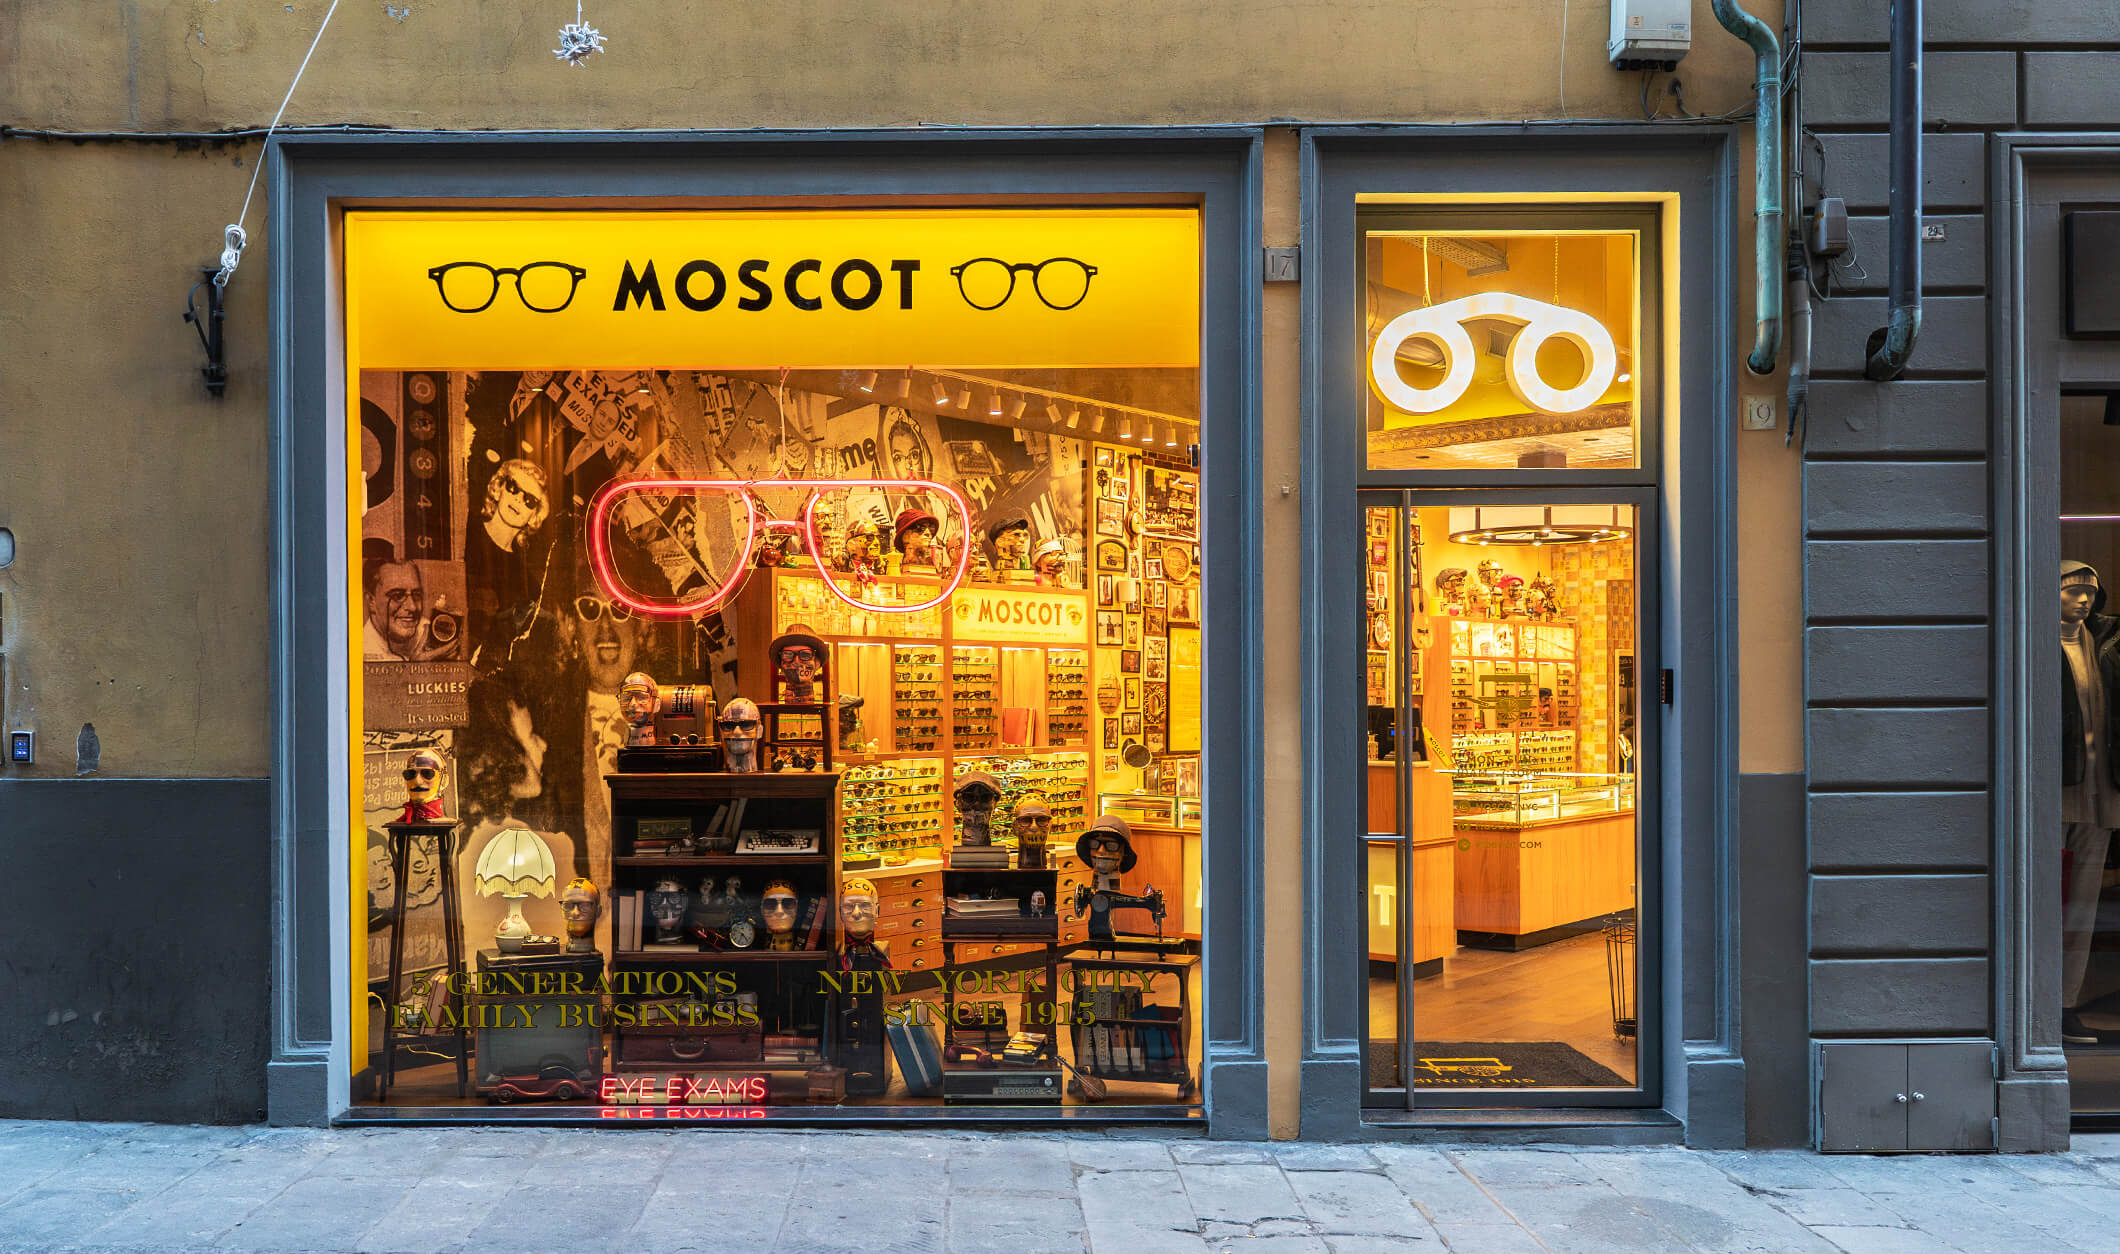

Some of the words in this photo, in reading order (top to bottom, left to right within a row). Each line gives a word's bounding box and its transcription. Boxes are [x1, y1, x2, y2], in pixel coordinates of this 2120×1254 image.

[1271, 254, 1295, 276] 17
[612, 258, 921, 312] MOSCOT
[416, 455, 433, 471] 3
[416, 493, 433, 509] 4
[416, 535, 433, 549] 5
[977, 597, 1063, 626] MOSCOT
[408, 681, 466, 694] LUCKIES
[427, 711, 467, 722] toasted
[411, 971, 431, 995] 5
[446, 971, 737, 995] GENERATIONS
[816, 970, 911, 994] NEW
[931, 970, 1049, 994] YORK
[1061, 970, 1163, 995] CITY
[391, 1004, 545, 1028] FAMILY
[556, 1004, 760, 1028] BUSINESS
[882, 1001, 1004, 1026] SINCE
[1020, 1001, 1096, 1026] 1915
[601, 1077, 657, 1099] EYE
[666, 1077, 766, 1099] EXAMS
